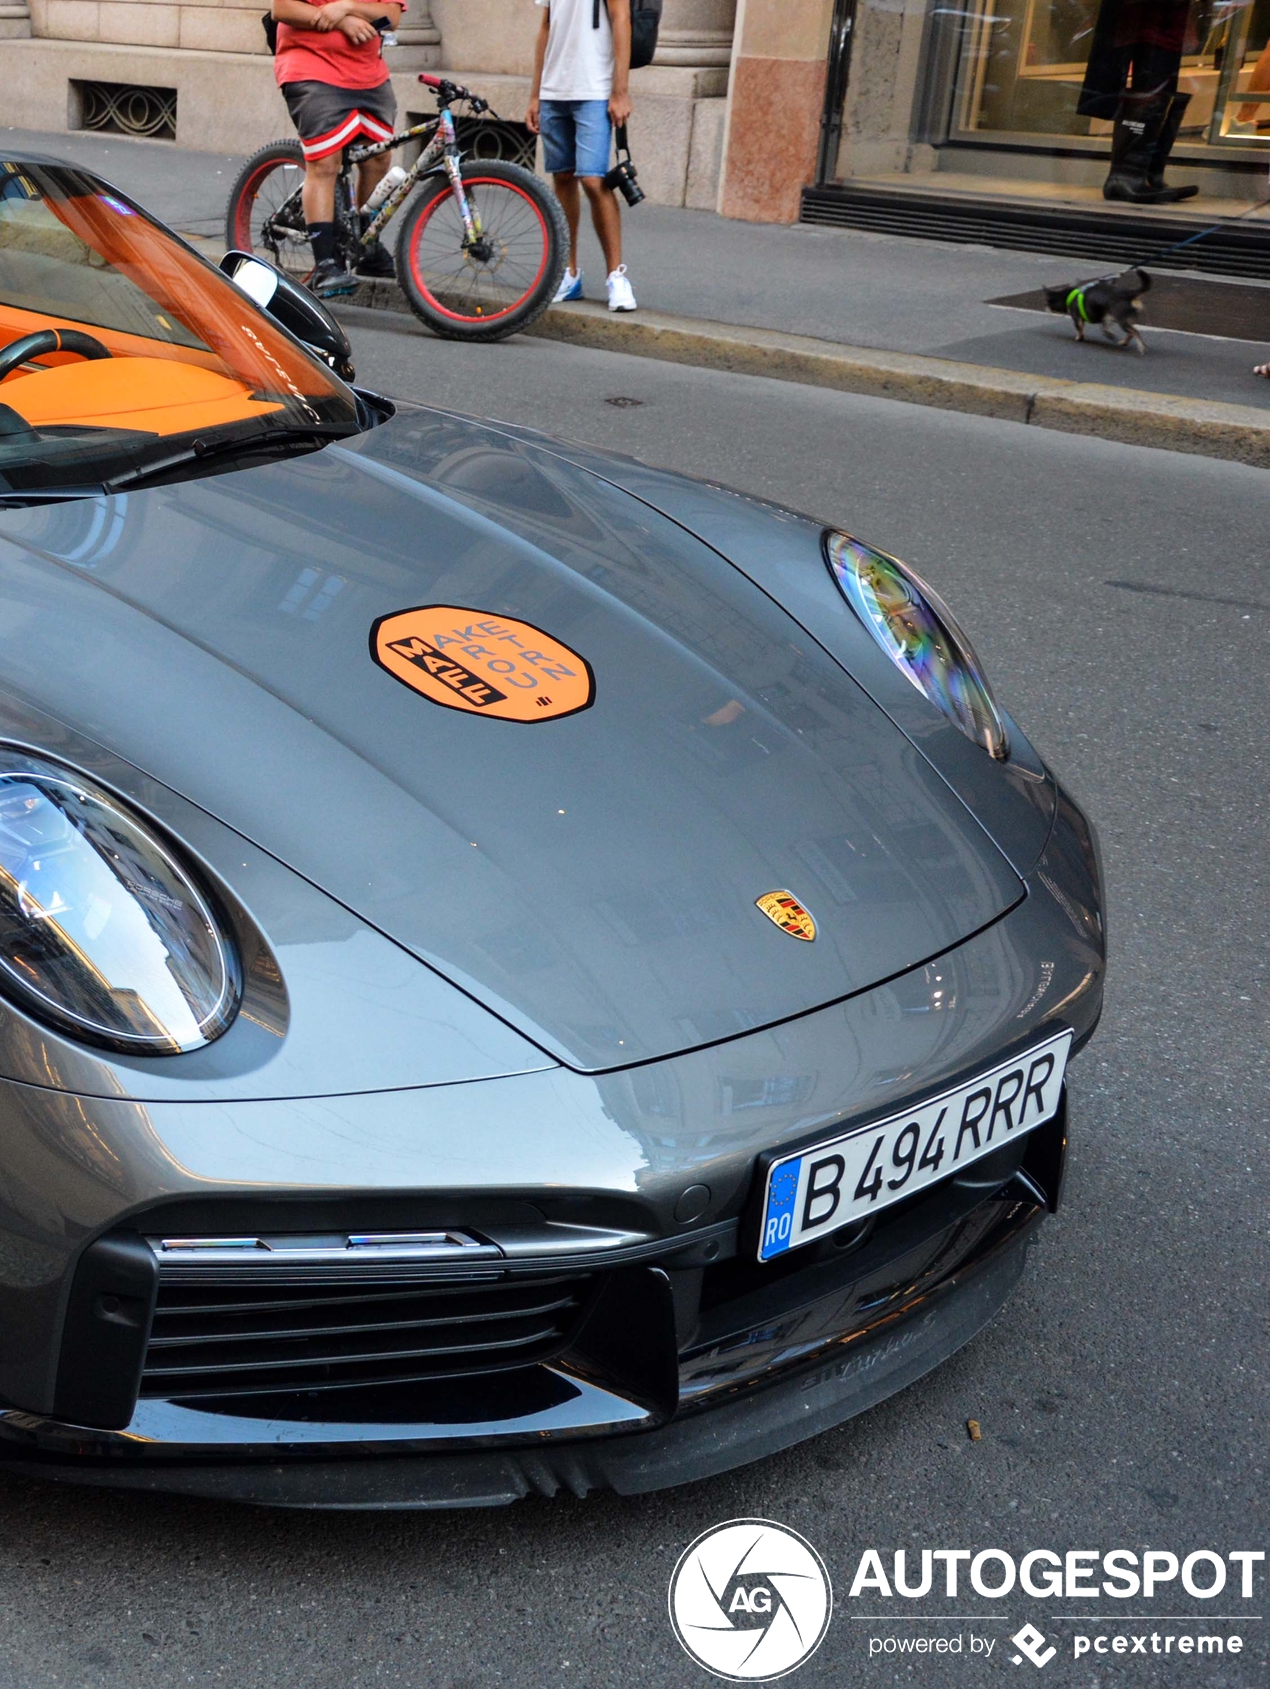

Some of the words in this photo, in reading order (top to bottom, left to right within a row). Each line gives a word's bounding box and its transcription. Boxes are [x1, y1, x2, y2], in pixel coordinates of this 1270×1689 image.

[801, 1153, 846, 1232] B
[853, 1106, 948, 1202] 494
[953, 1052, 1055, 1161] RRR
[764, 1212, 792, 1247] RO
